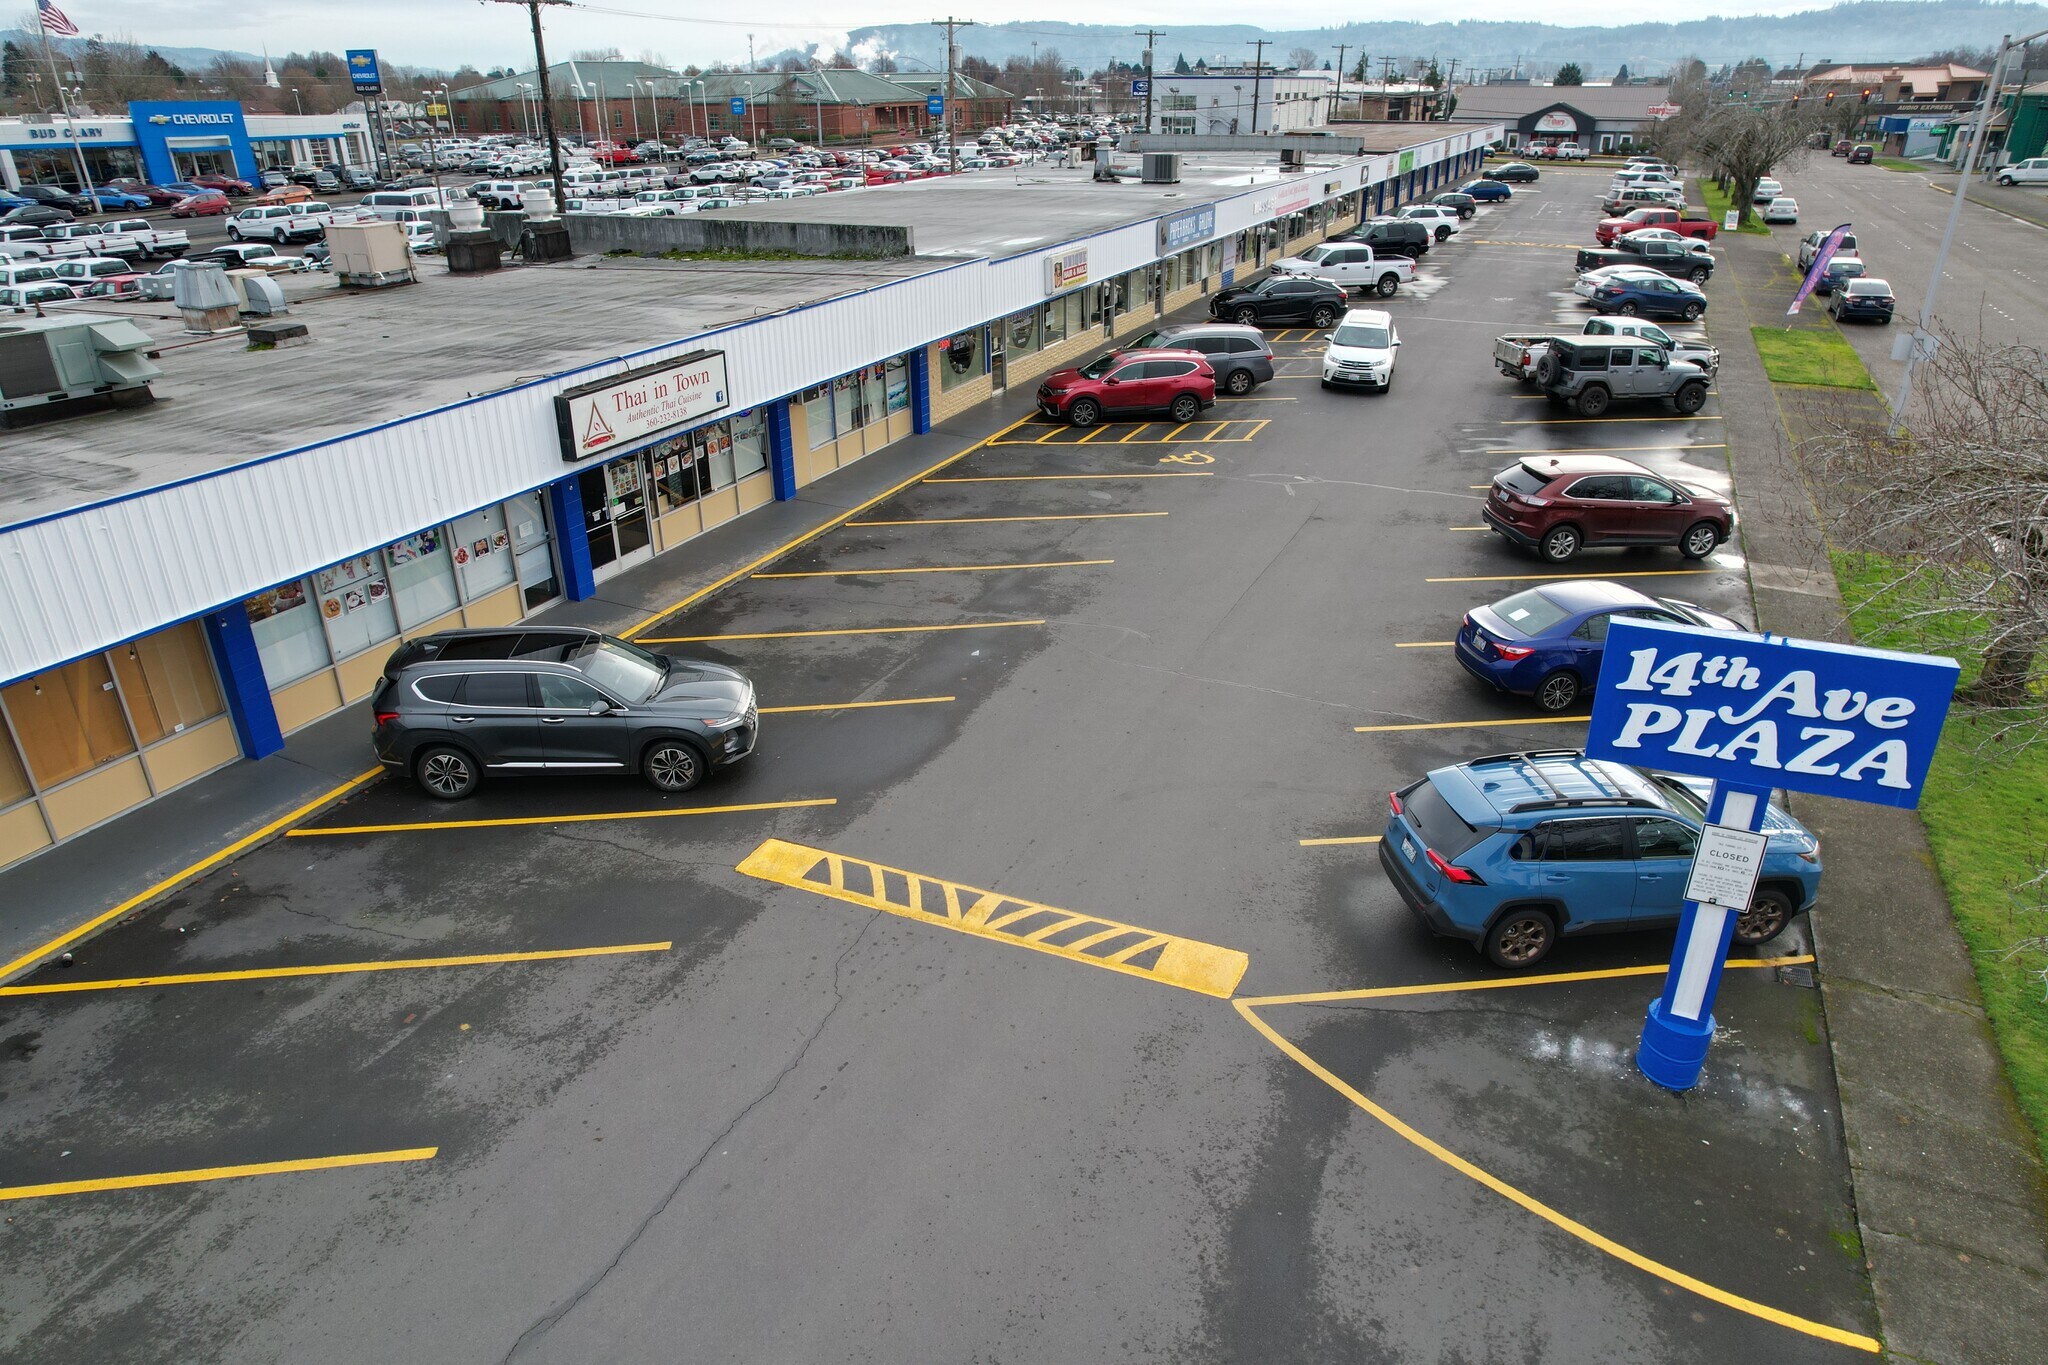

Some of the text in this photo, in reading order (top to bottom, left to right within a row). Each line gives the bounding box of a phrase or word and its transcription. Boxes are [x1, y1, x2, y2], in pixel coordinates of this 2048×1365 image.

[30, 128, 57, 139] BUD
[172, 113, 234, 125] CHEVROLET
[1169, 211, 1213, 241] PAPERBACKS GALORE
[612, 371, 710, 412] Thai in Town
[627, 391, 703, 423] Authentic Thai Cuisine
[647, 407, 688, 428] 360-232-8138
[1615, 647, 1916, 730] 14th Ave
[1612, 703, 1912, 790] PLAZA
[1709, 849, 1750, 863] CLOSED
